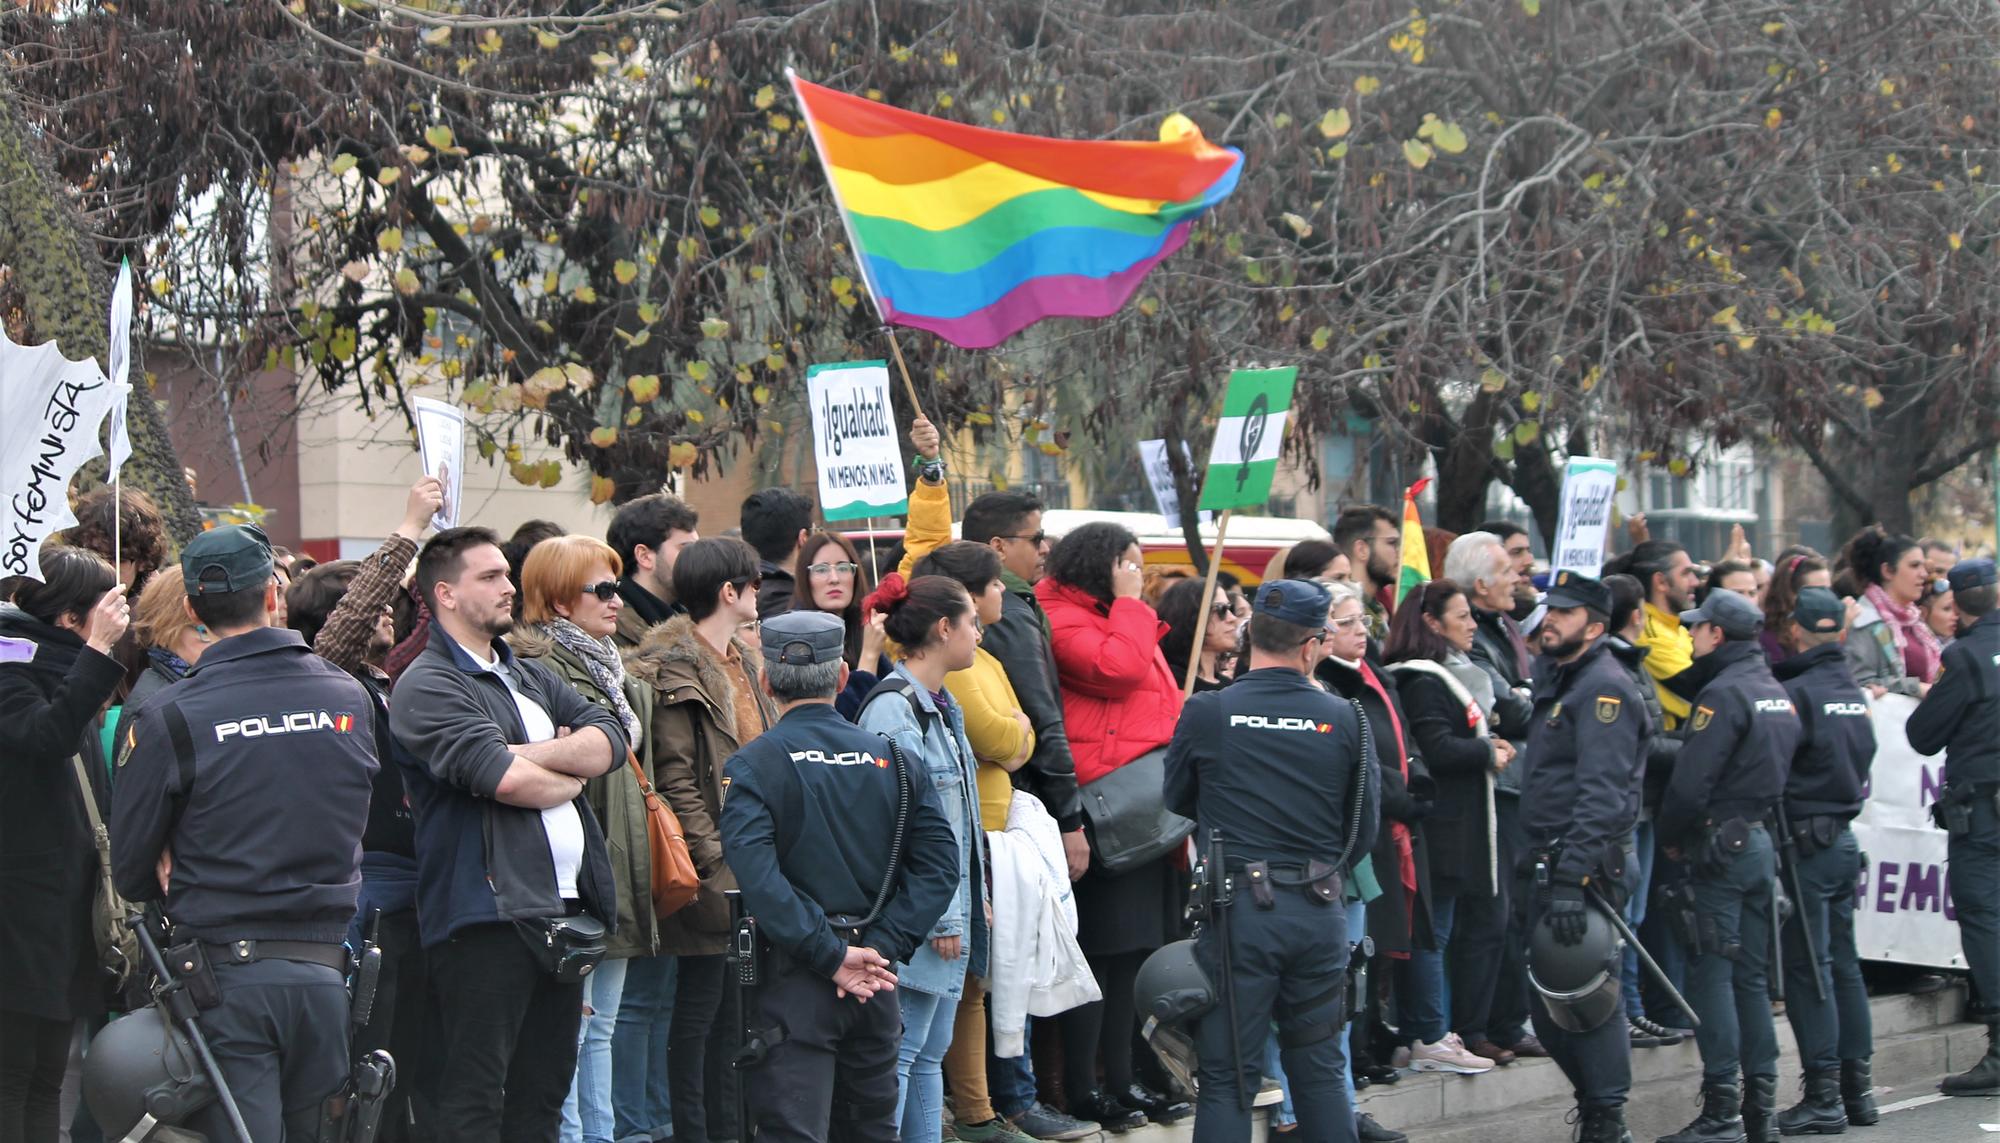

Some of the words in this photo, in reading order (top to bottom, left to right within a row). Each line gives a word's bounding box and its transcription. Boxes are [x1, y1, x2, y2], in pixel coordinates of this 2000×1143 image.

[822, 385, 889, 457] ¡Igualdad!
[827, 466, 838, 489] NI
[837, 464, 870, 491] MENOS,
[868, 464, 879, 486] NI
[878, 456, 898, 485] MÁS.
[3, 522, 37, 575] SOY
[214, 711, 336, 743] POLICIA
[1230, 715, 1318, 731] POLICIA
[789, 750, 876, 766] POLICIA
